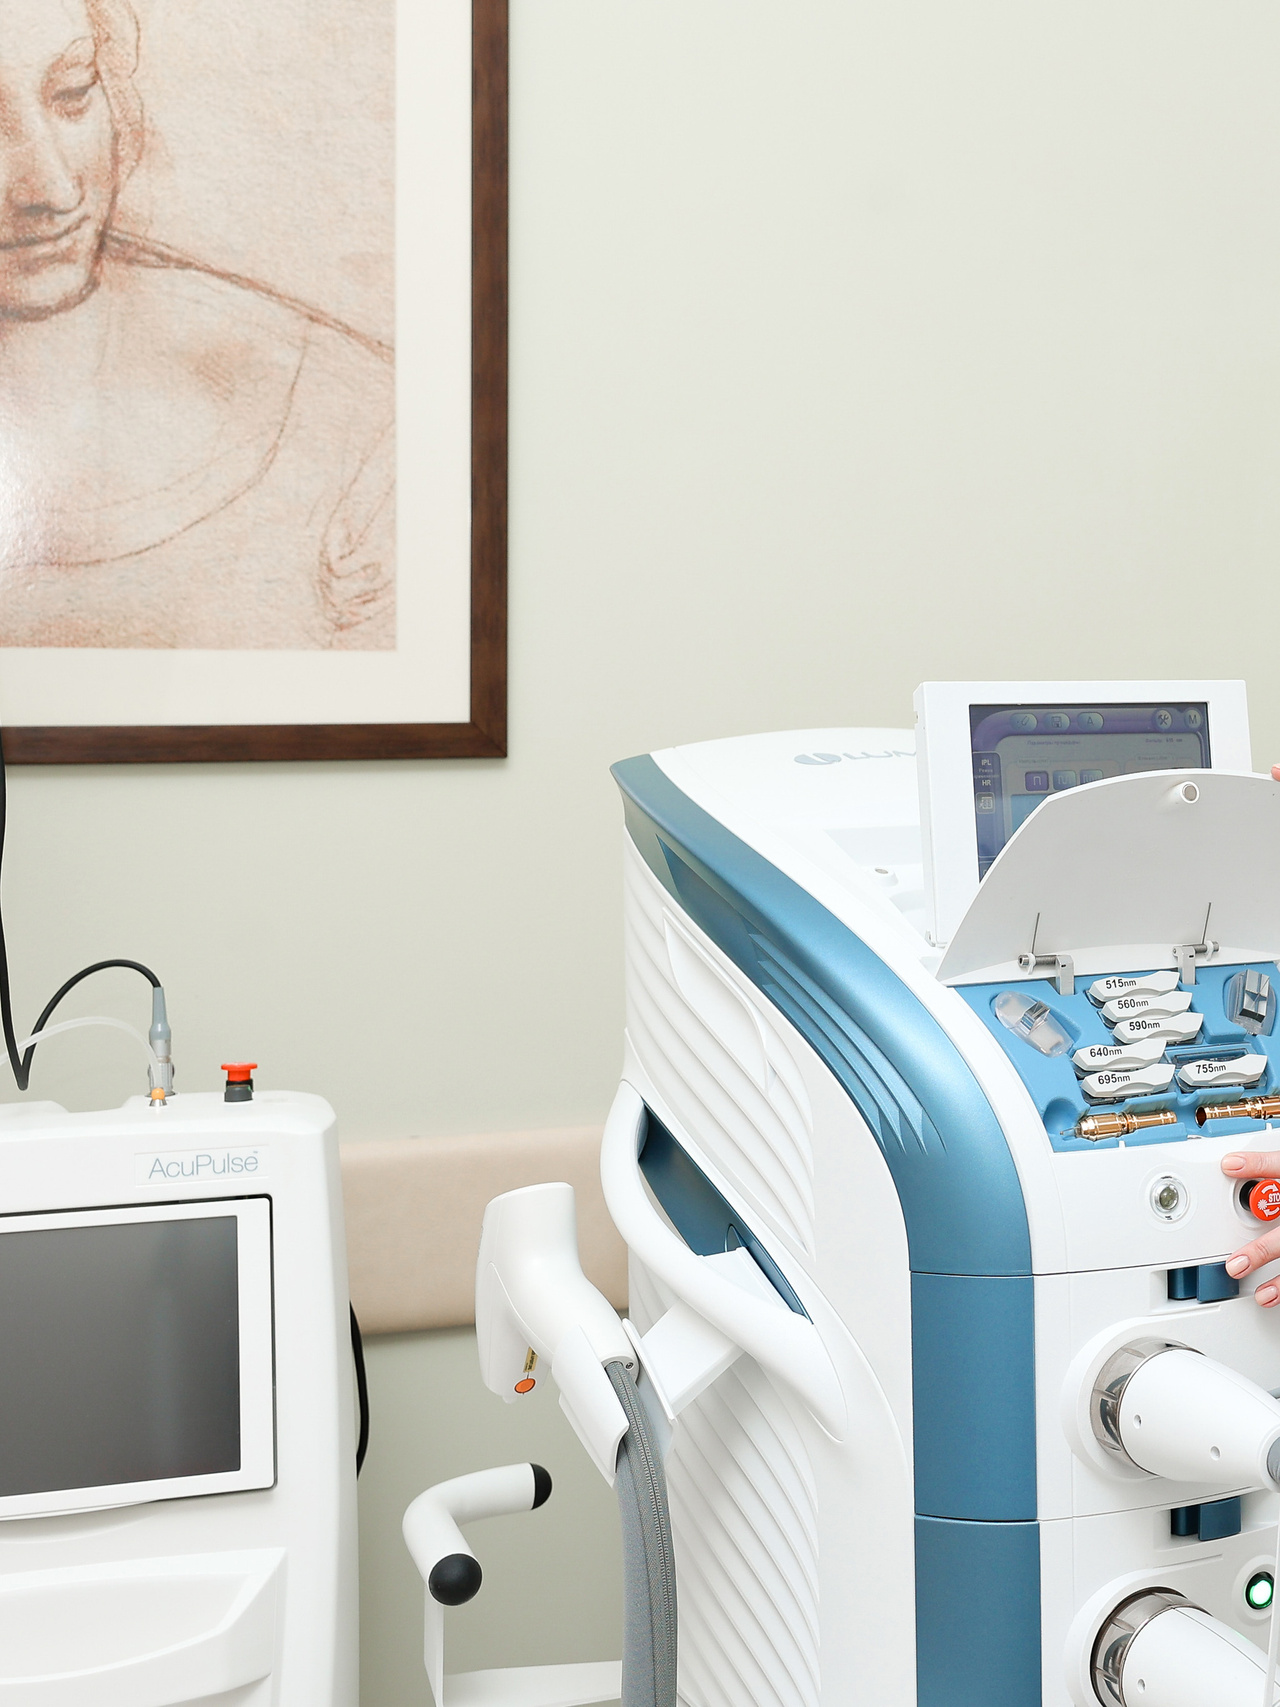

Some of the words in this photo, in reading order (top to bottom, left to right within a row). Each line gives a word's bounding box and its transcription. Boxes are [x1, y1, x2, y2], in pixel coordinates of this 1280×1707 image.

[1105, 978, 1137, 990] 515nm
[1117, 999, 1149, 1010] 560nm
[1129, 1020, 1161, 1031] 590nm
[1089, 1047, 1123, 1058] 640nm
[1195, 1063, 1227, 1075] 755nm
[1097, 1073, 1131, 1085] 695nm
